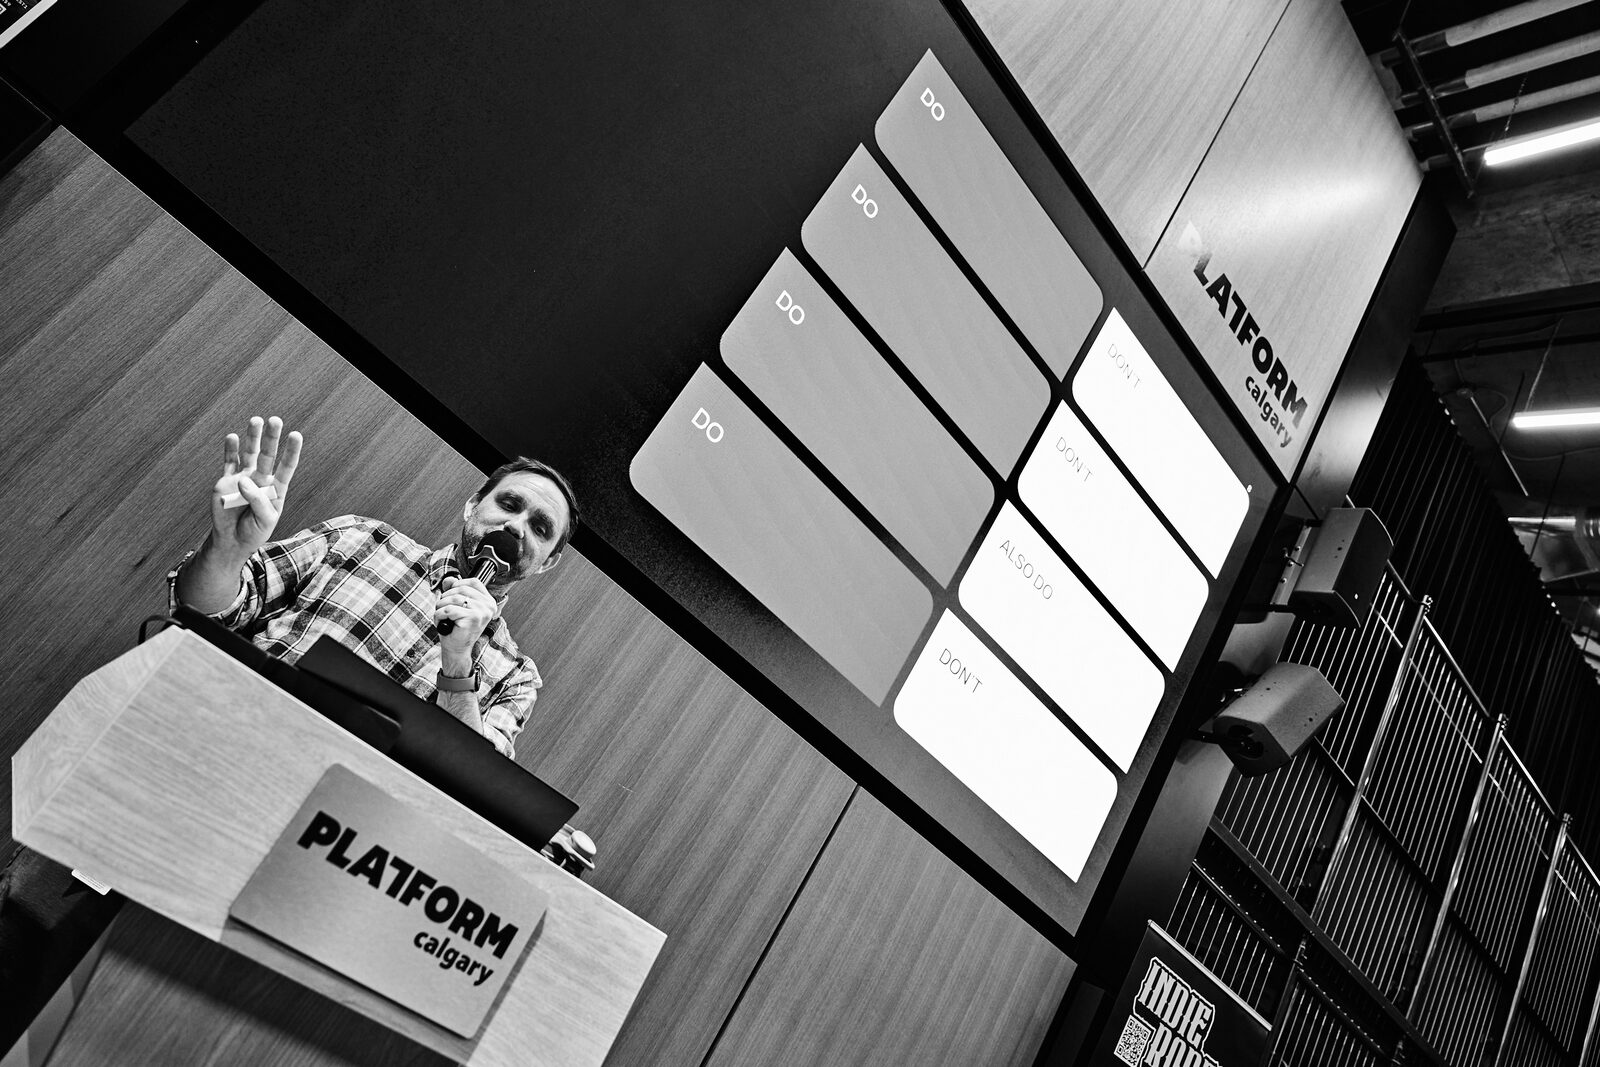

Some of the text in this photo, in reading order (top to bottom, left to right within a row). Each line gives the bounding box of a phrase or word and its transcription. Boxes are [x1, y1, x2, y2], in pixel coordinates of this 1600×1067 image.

[920, 87, 945, 121] DO
[851, 184, 878, 218] DO
[776, 289, 806, 325] DO
[691, 407, 724, 443] DO
[1245, 375, 1292, 448] calgary
[1056, 436, 1093, 482] DON'T
[999, 539, 1054, 600] ALSO DO
[938, 648, 983, 693] DON'T
[297, 810, 519, 959] PLATFORM
[413, 931, 494, 986] calgary
[1137, 964, 1213, 1049] INDIE
